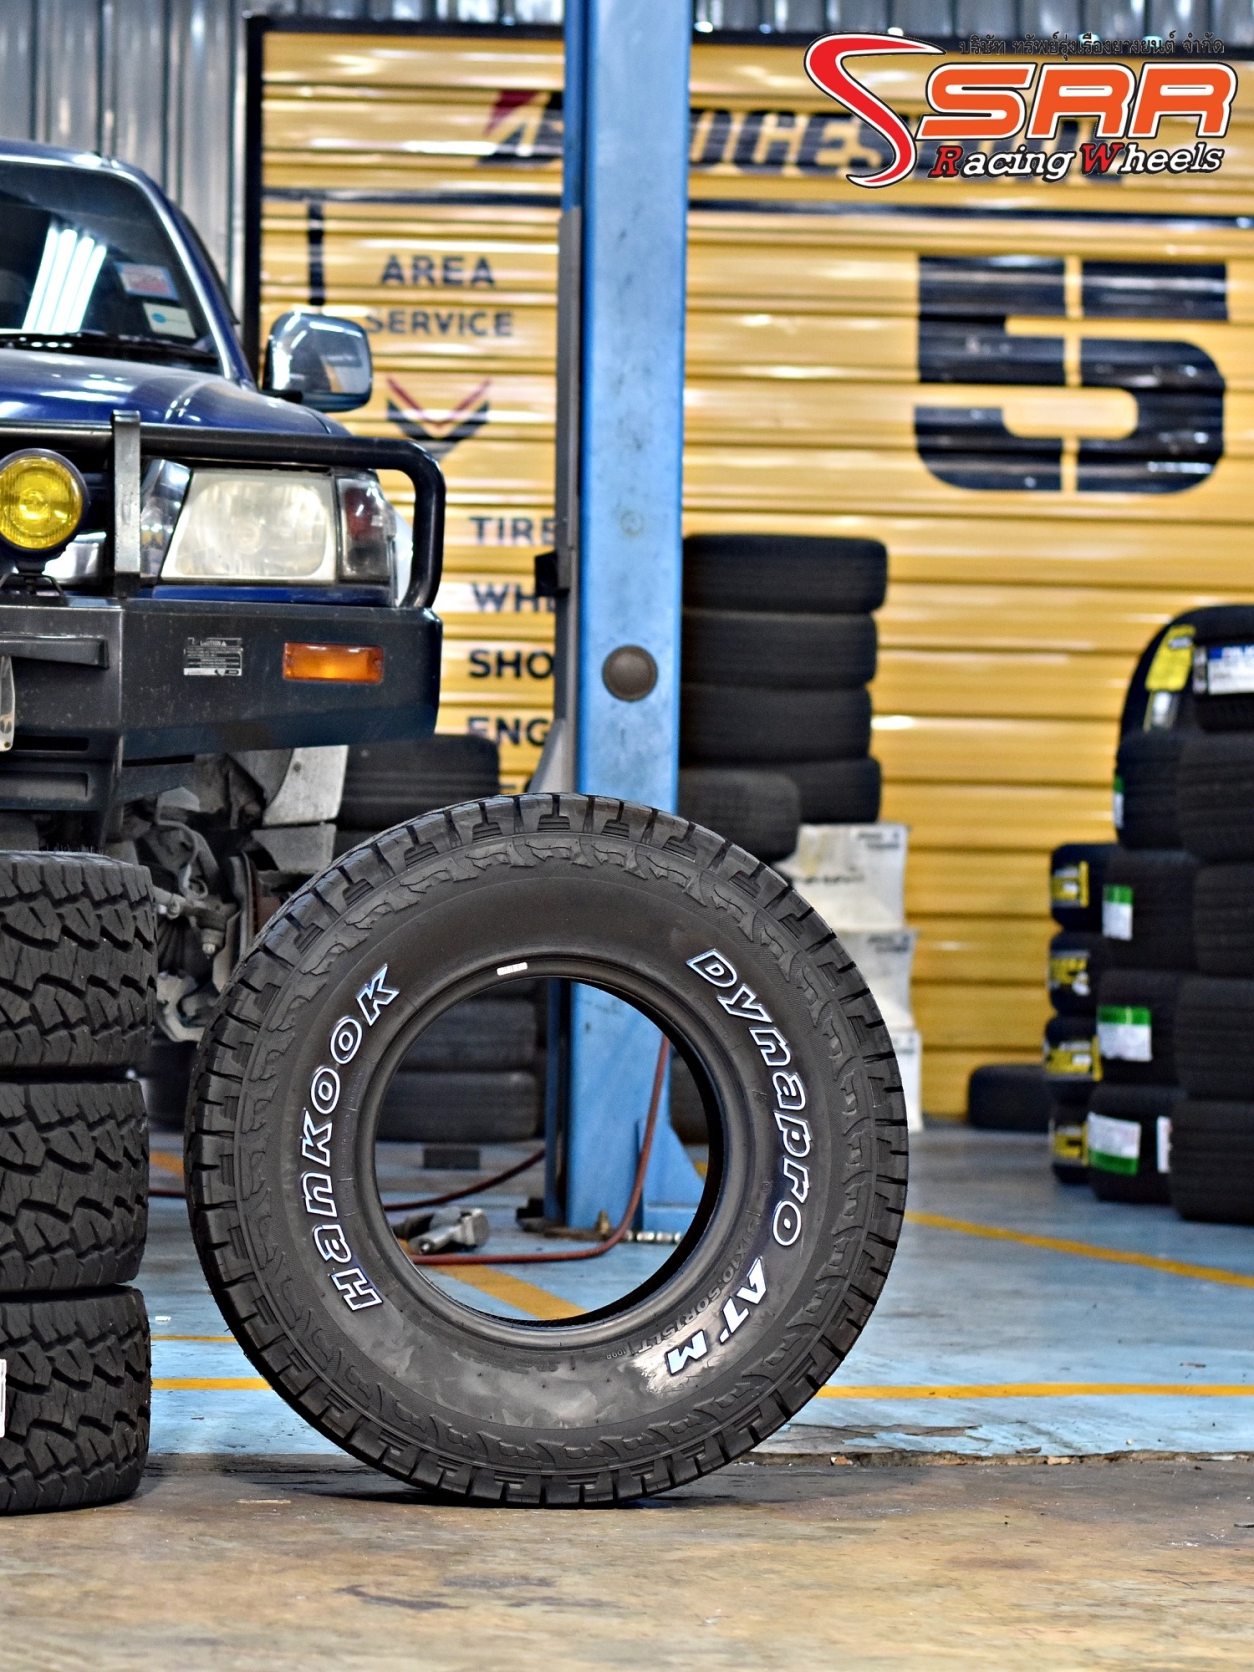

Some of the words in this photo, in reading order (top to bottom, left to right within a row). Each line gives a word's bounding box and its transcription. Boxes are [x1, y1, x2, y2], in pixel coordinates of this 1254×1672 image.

[381, 254, 495, 286] AREA
[365, 309, 513, 336] SERVICE
[914, 255, 1230, 494] 5
[468, 648, 555, 680] SHO
[467, 716, 552, 747] ENG
